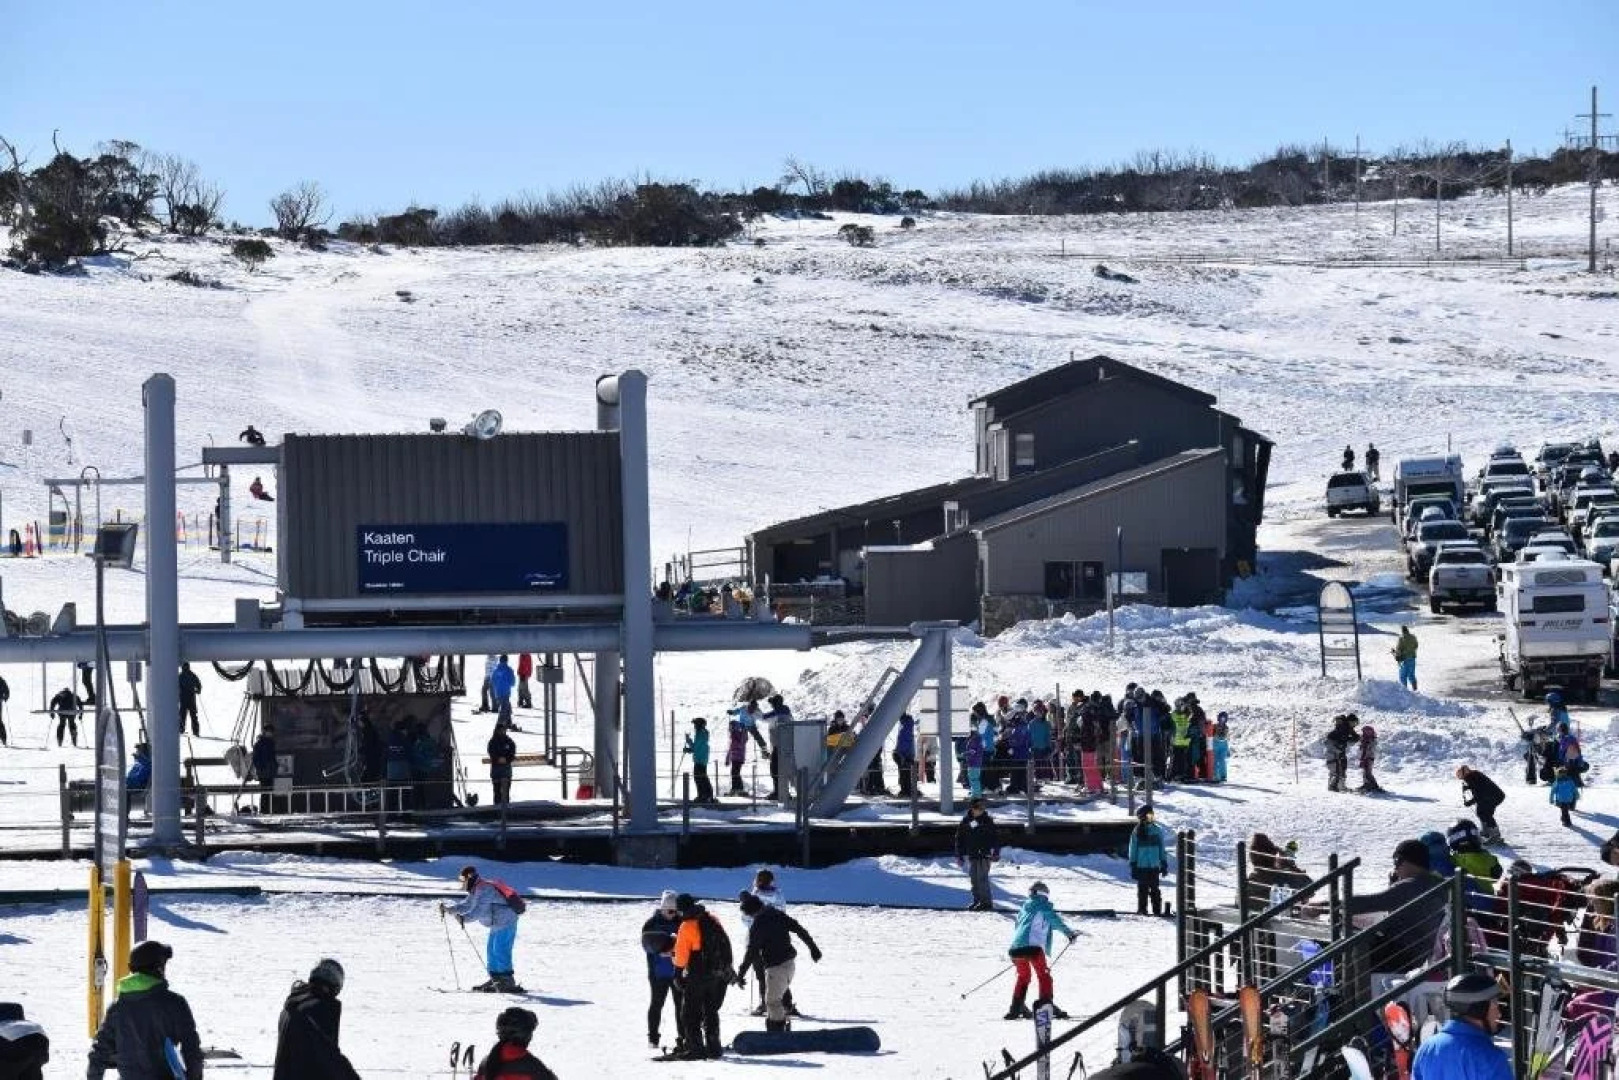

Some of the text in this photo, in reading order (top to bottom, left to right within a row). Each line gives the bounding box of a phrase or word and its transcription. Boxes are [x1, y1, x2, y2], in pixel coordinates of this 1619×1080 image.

[364, 532, 415, 544] Kaaten
[364, 548, 446, 565] Triple Chair
